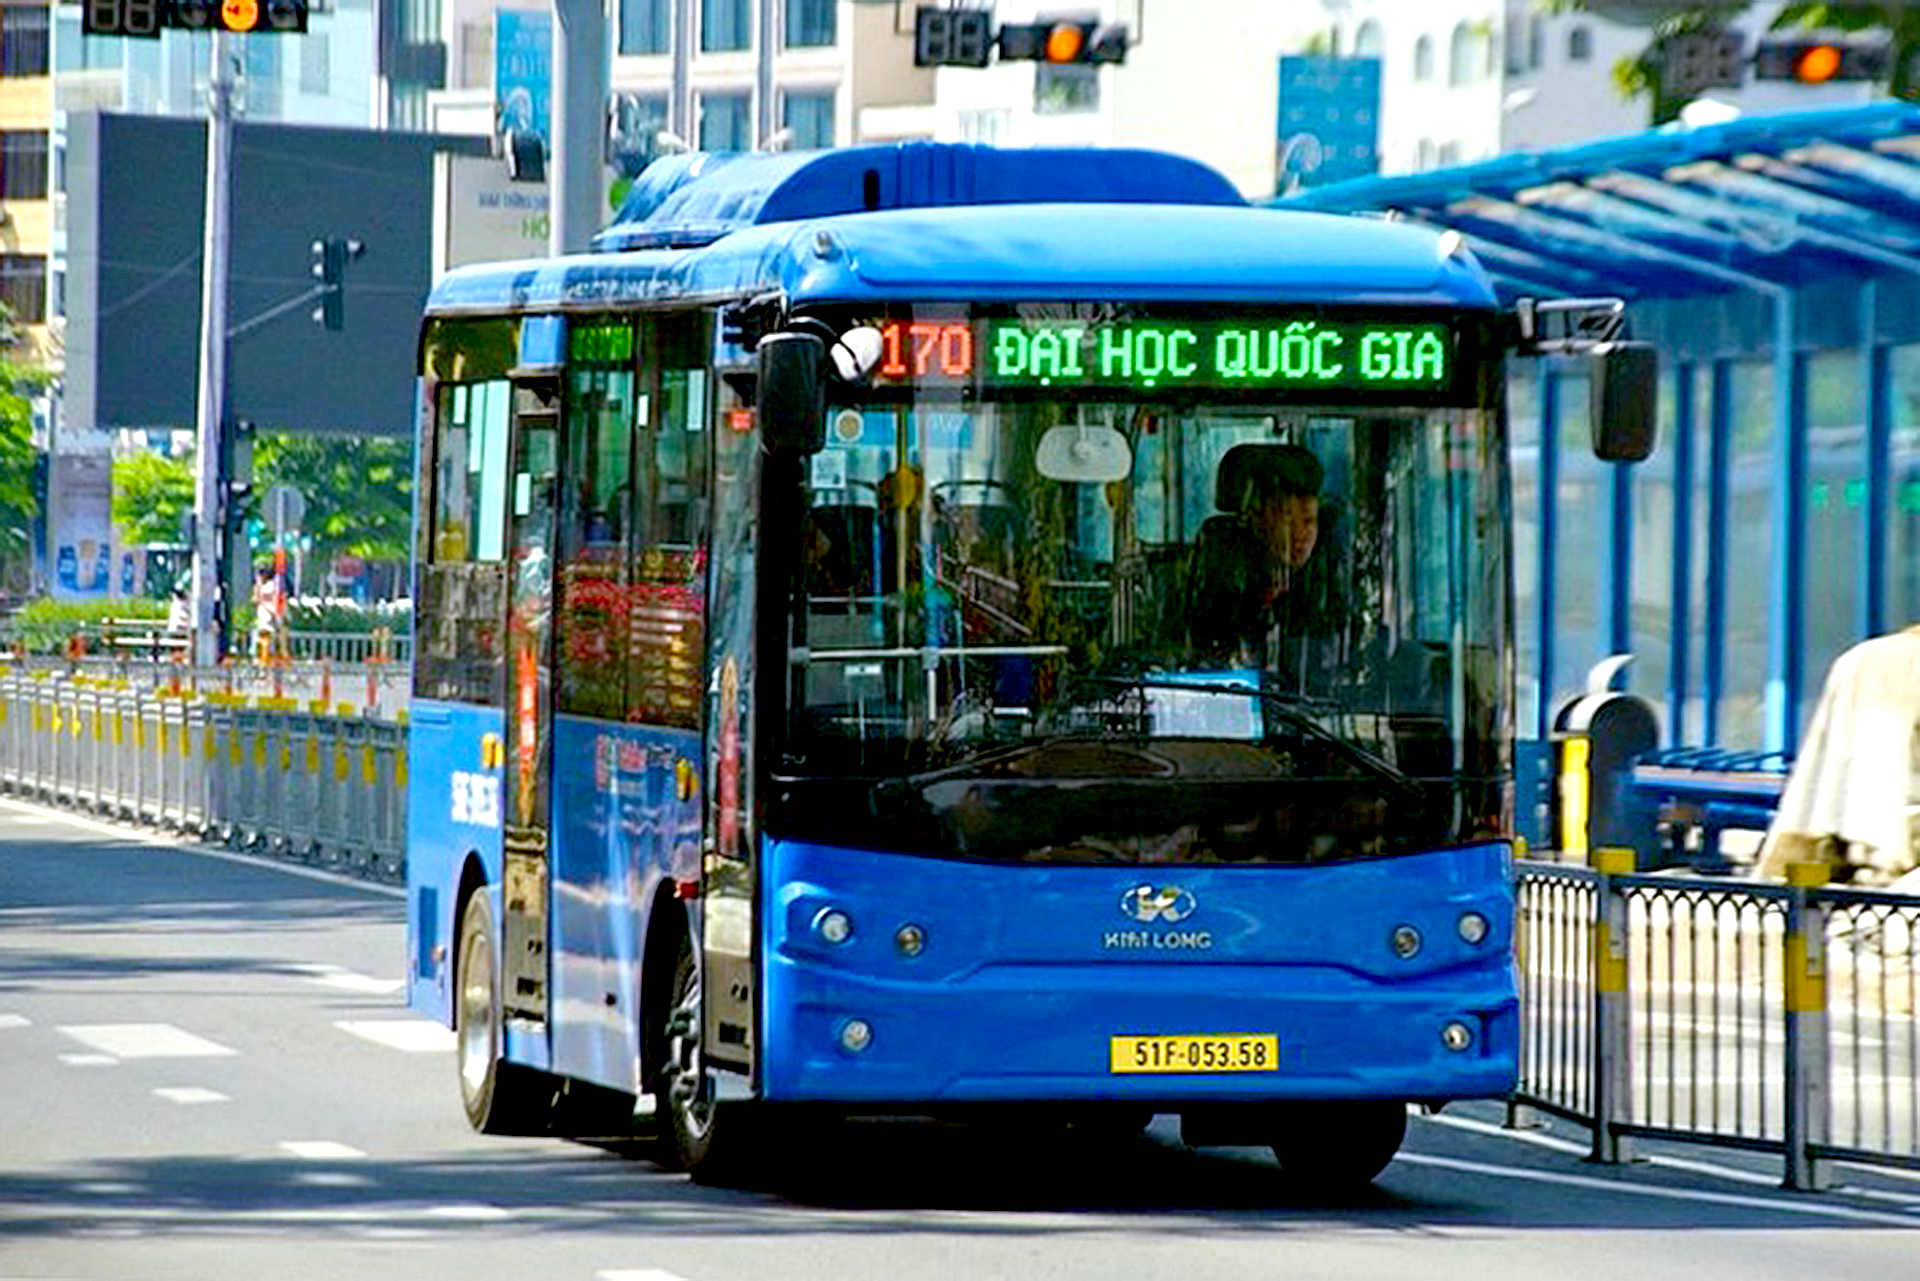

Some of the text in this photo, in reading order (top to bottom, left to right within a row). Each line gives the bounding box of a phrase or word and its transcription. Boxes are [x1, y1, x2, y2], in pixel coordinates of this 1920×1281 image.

[883, 321, 1443, 386] 170 ĐẠI HỌC QUỐC GIA
[1152, 932, 1212, 949] LONG
[1135, 1041, 1267, 1067] 51F-053.58
